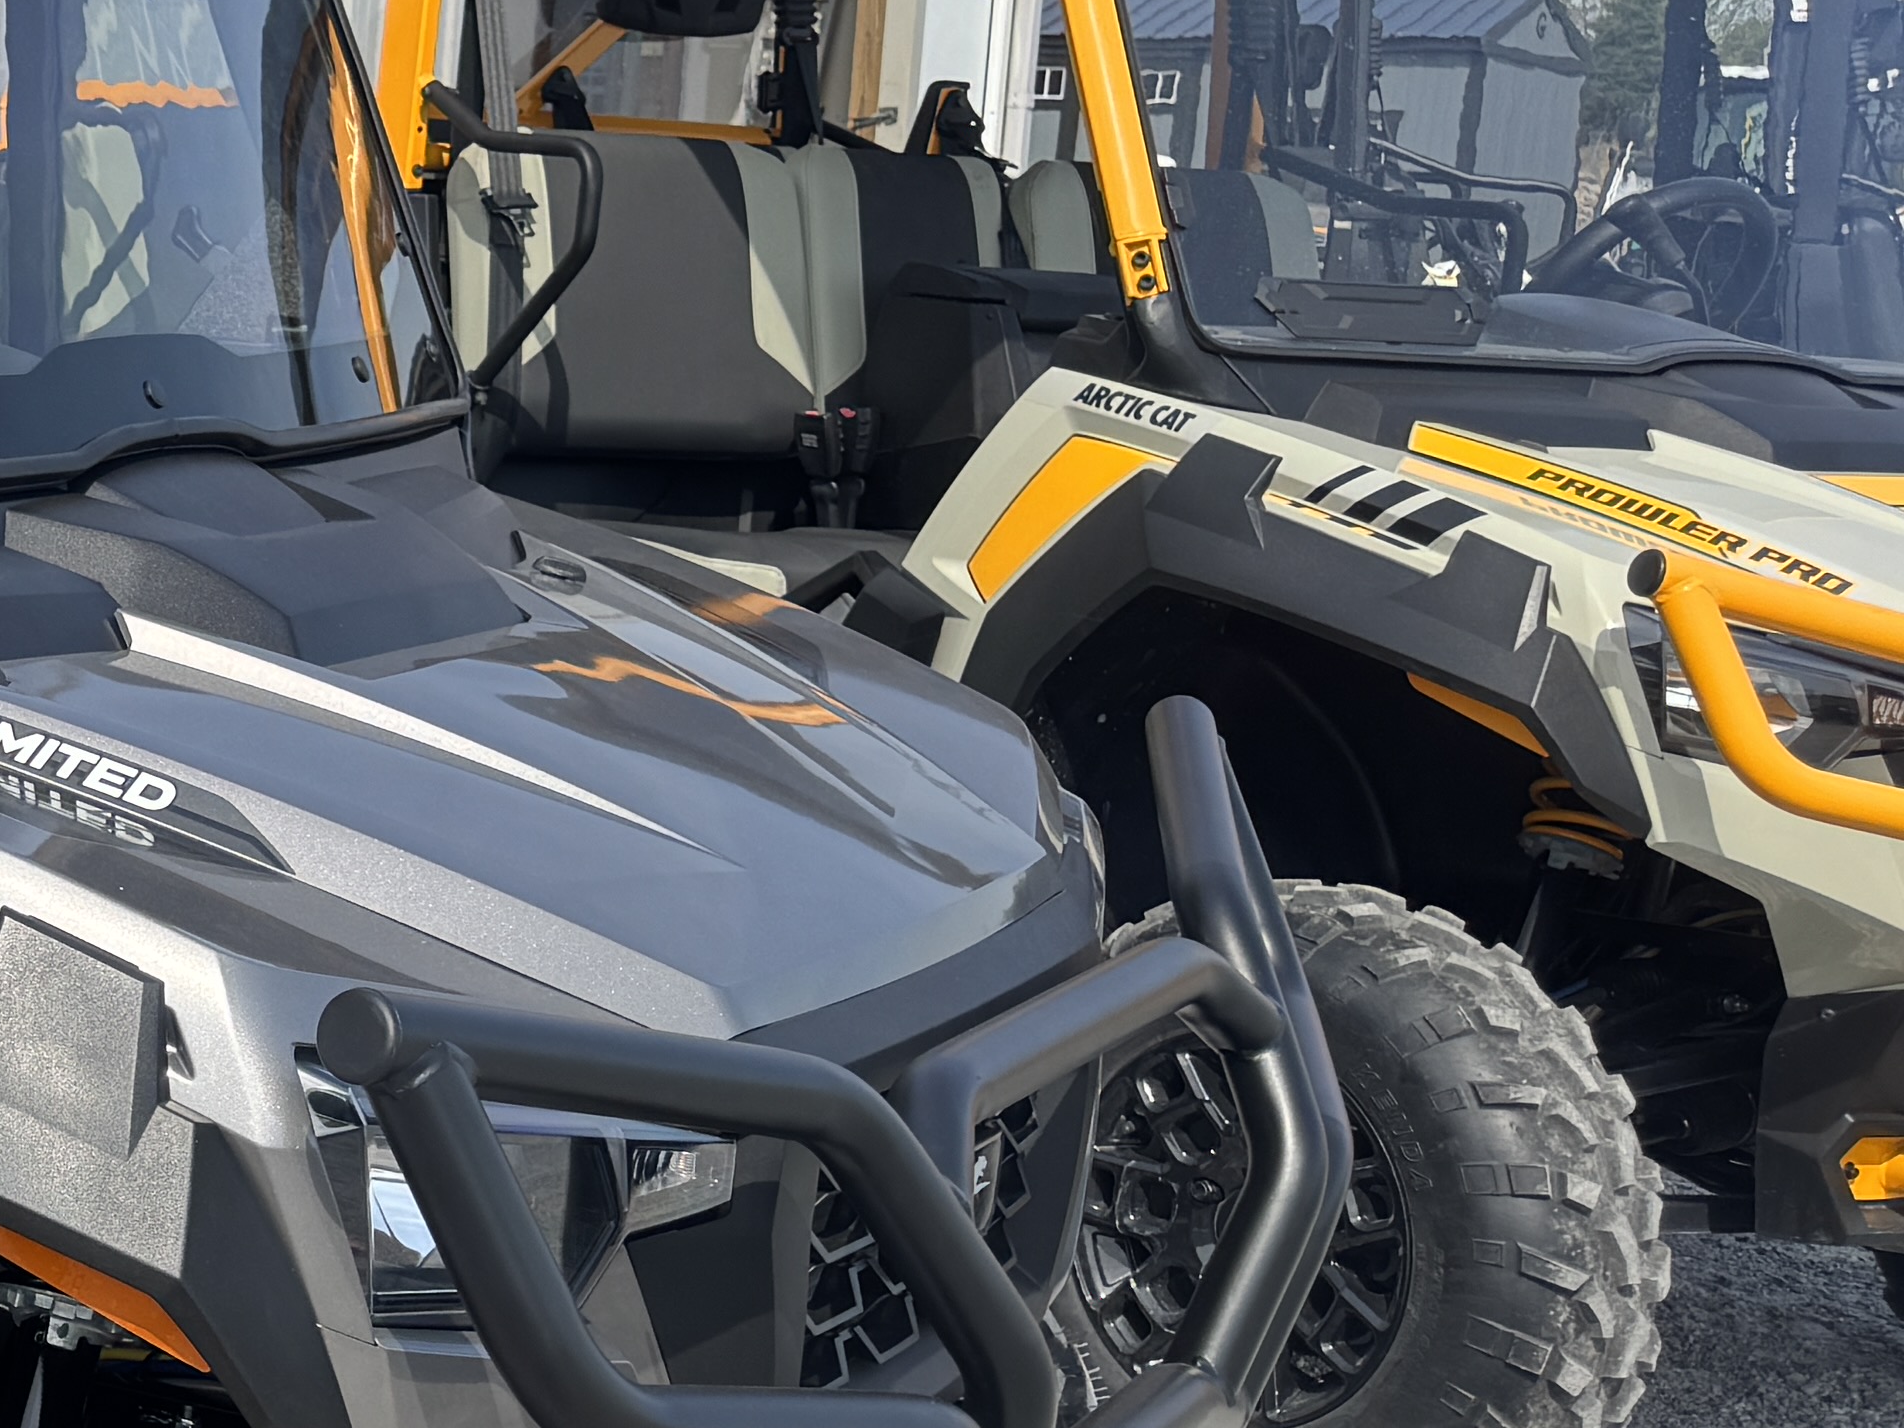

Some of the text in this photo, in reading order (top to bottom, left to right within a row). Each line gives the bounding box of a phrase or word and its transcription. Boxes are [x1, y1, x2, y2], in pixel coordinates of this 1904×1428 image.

[1073, 382, 1197, 433] ARCTIC CAT
[1527, 467, 1748, 559] PROWLER
[1749, 545, 1854, 597] PRO
